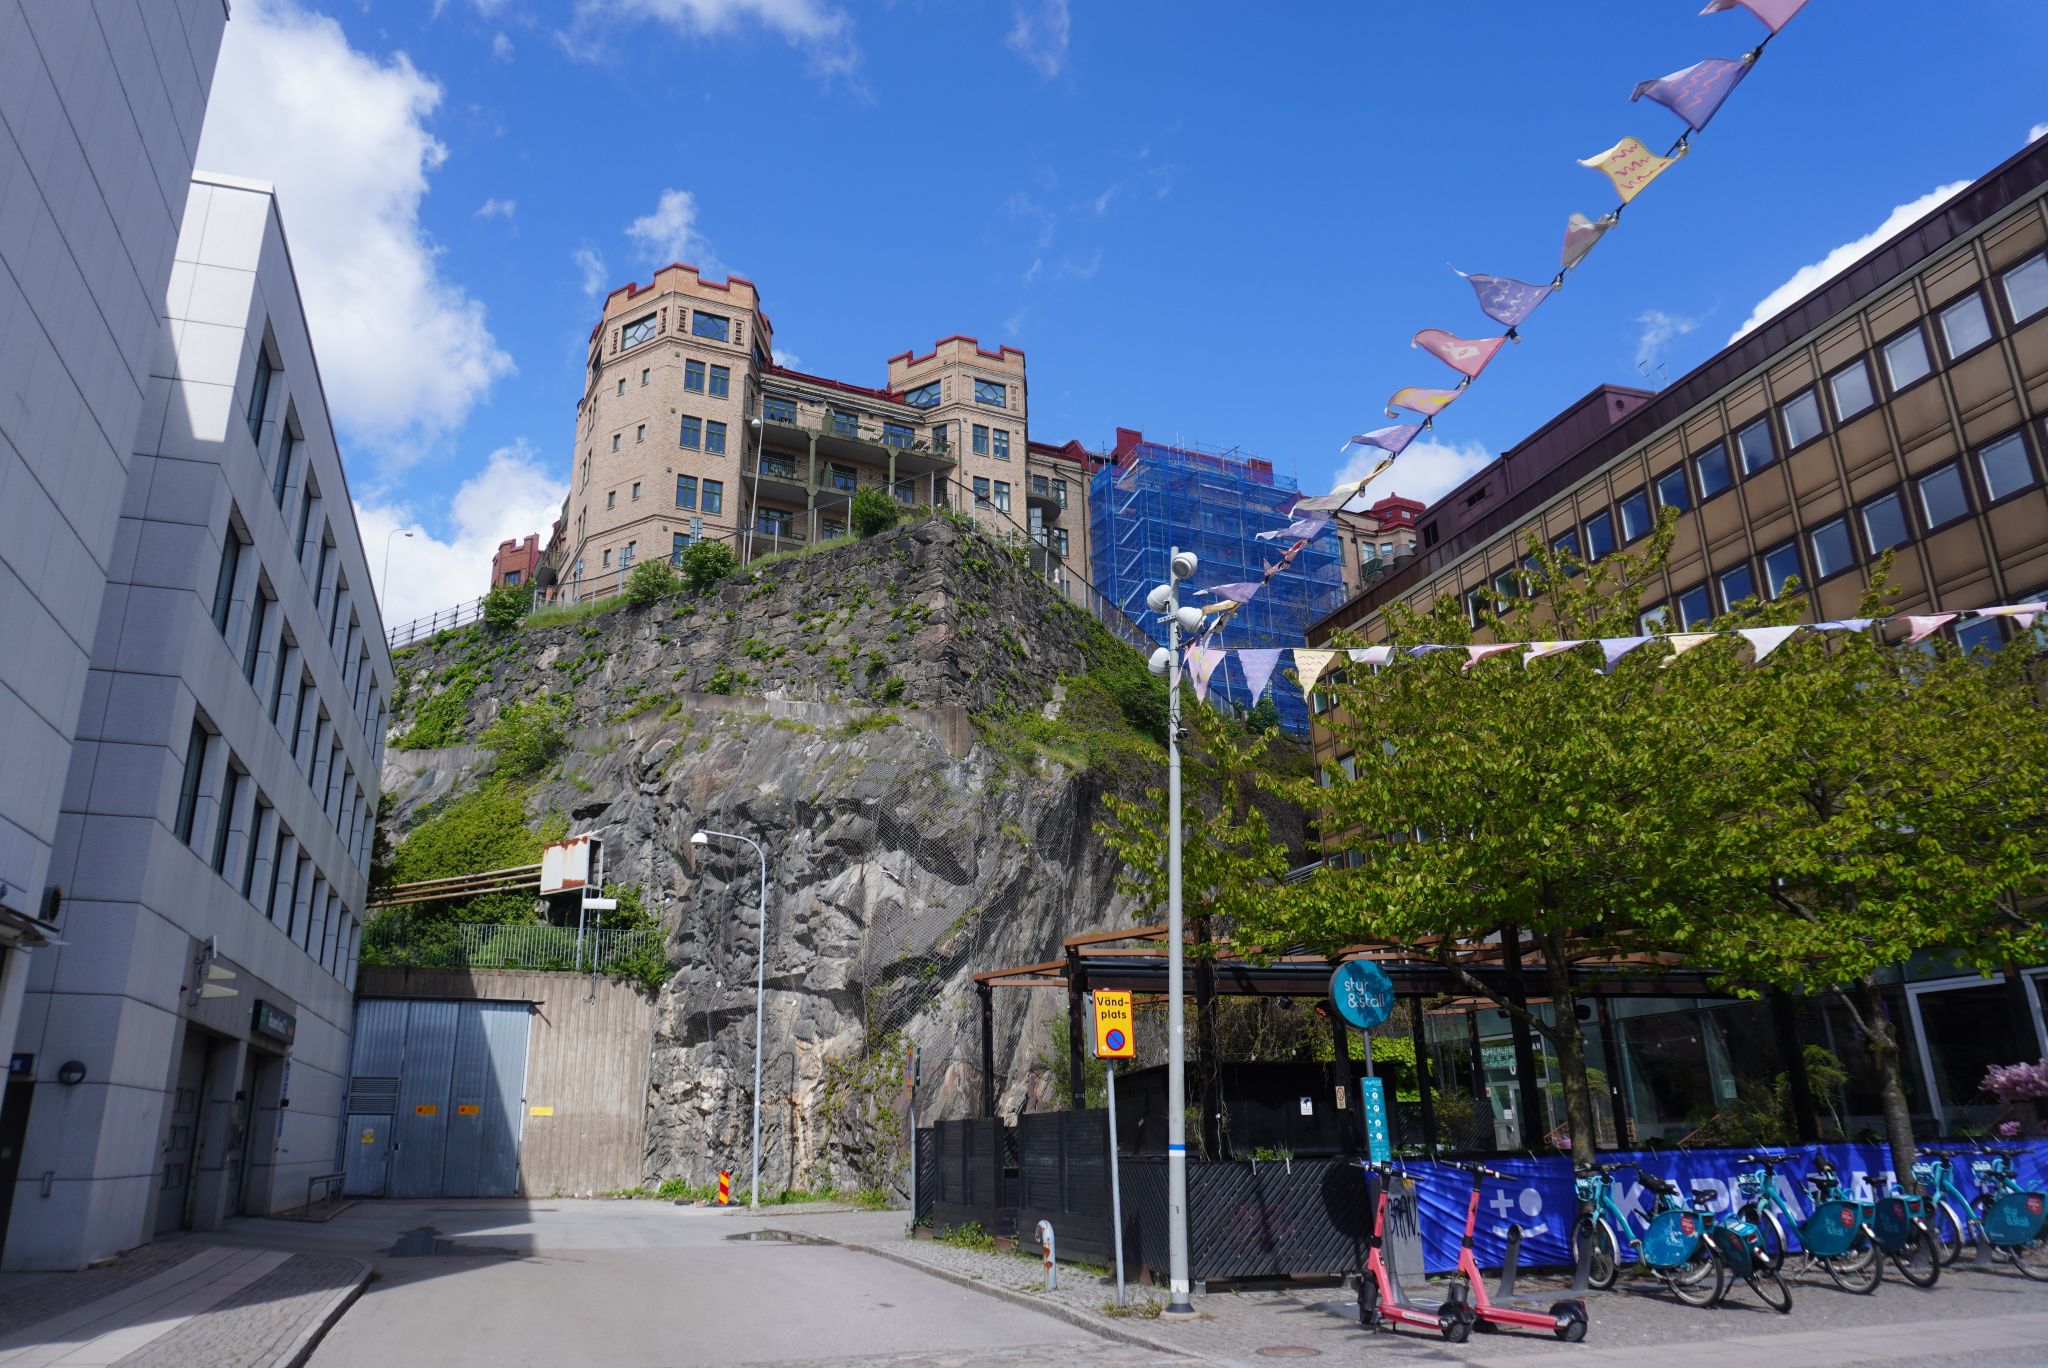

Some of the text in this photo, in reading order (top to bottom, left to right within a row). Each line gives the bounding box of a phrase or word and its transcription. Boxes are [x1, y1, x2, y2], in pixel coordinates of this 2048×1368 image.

[1344, 976, 1369, 996] styr
[1097, 996, 1130, 1007] Vänd-
[1347, 992, 1386, 1009] &ställ
[1101, 1010, 1128, 1021] plats
